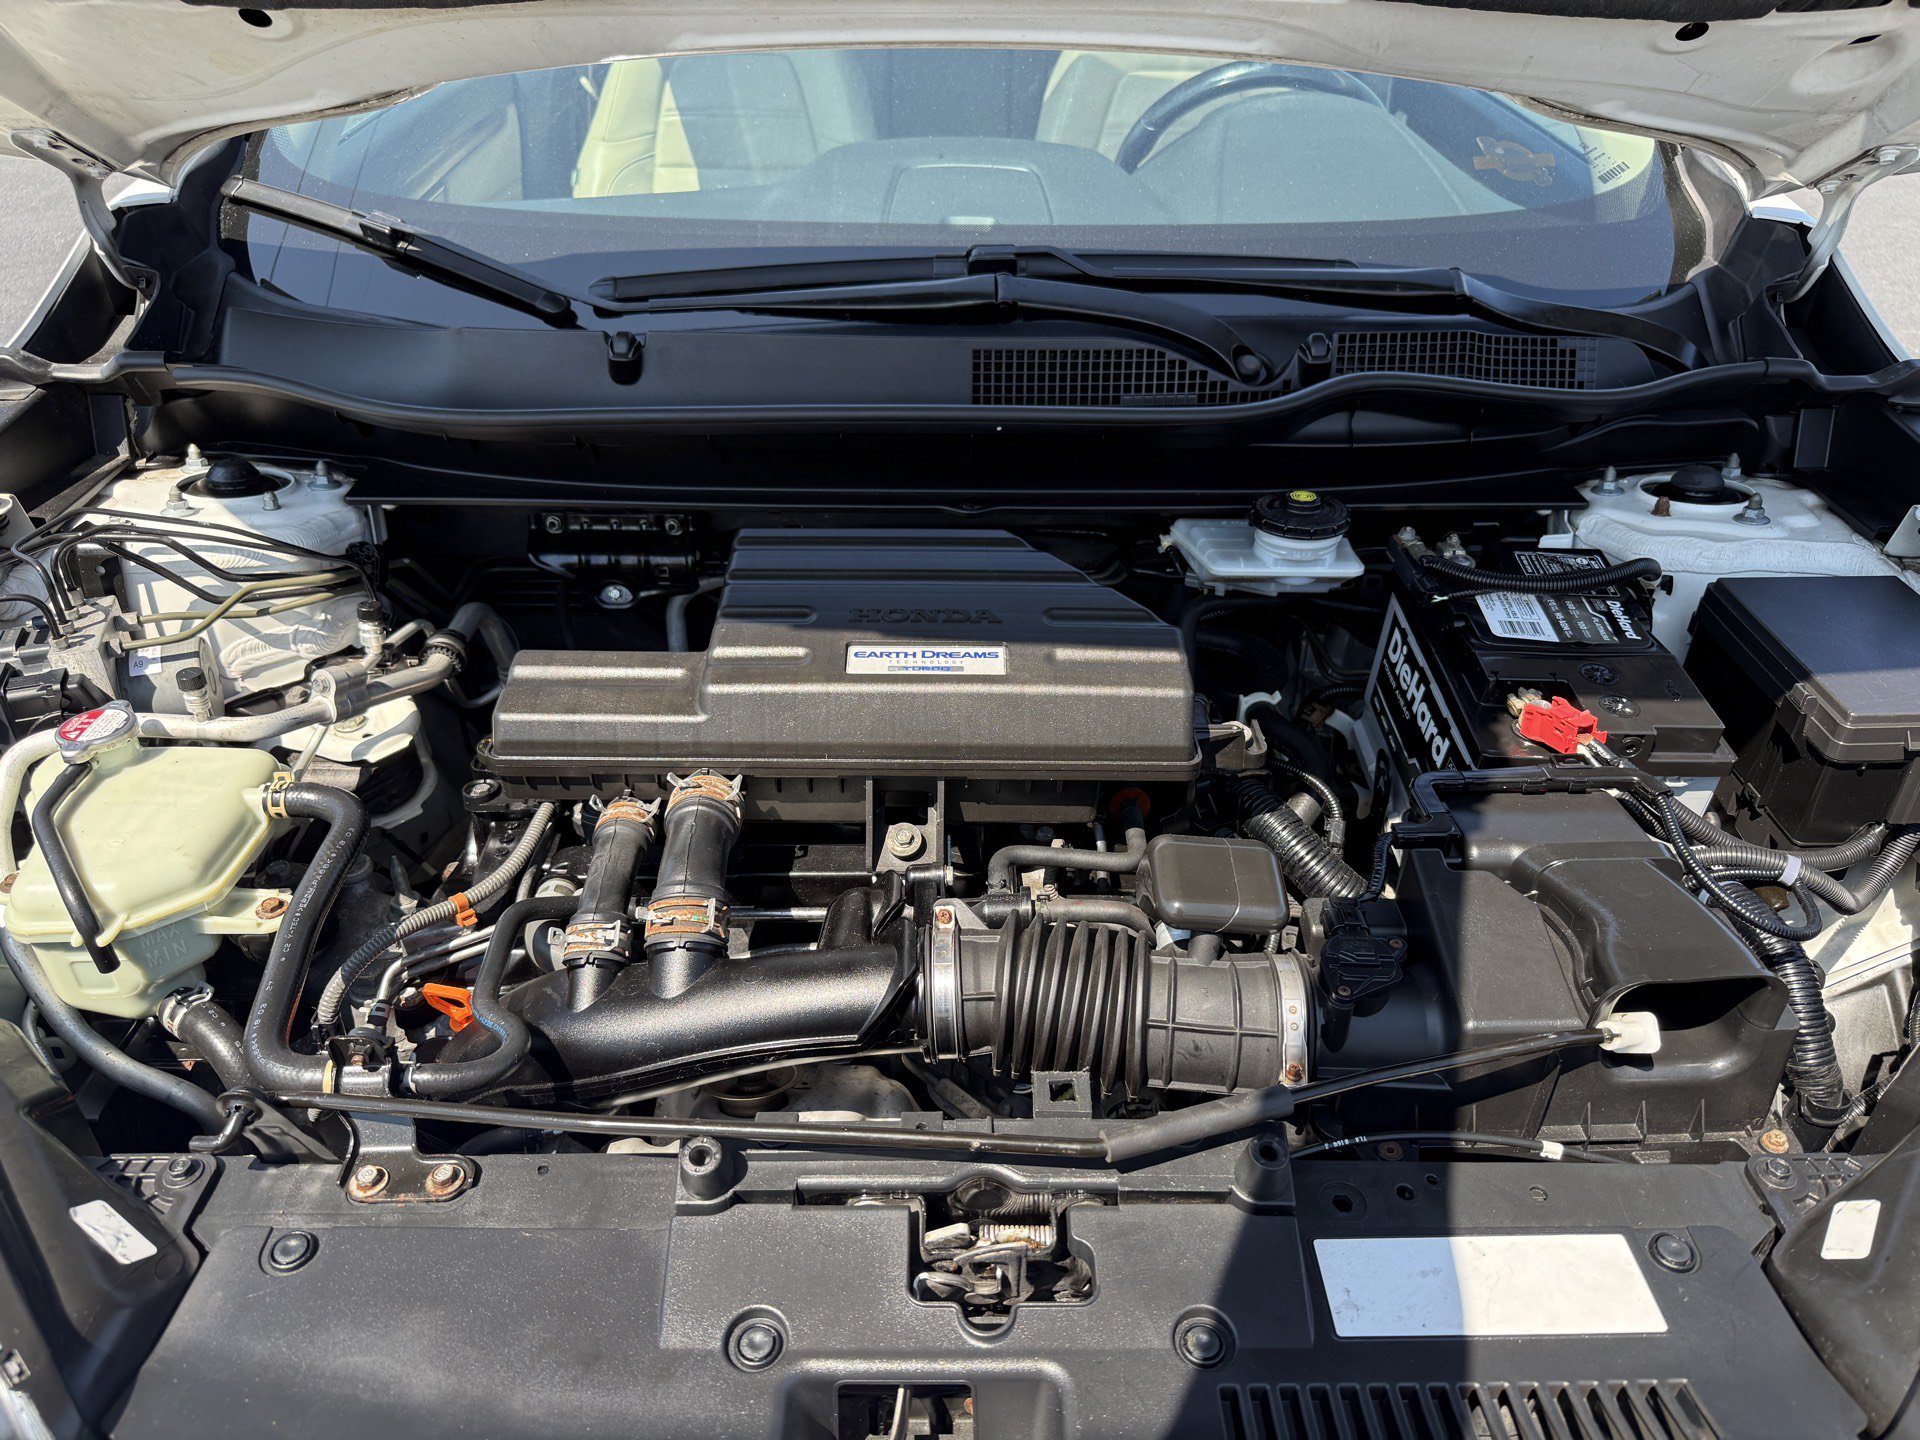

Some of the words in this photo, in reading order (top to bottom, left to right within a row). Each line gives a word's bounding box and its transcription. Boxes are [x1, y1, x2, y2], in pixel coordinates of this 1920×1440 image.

[849, 608, 1003, 624] HONDA
[1606, 600, 1642, 640] DieHard
[1591, 617, 1611, 641] PLATINUM
[133, 660, 144, 669] A9
[853, 651, 917, 659] EARTH
[921, 650, 999, 659] DREAMS
[1382, 658, 1397, 690] POWER
[1394, 689, 1411, 721] AHEAD
[1387, 626, 1450, 770] DieHard
[140, 923, 181, 948] MAX
[145, 938, 188, 968] MIN
